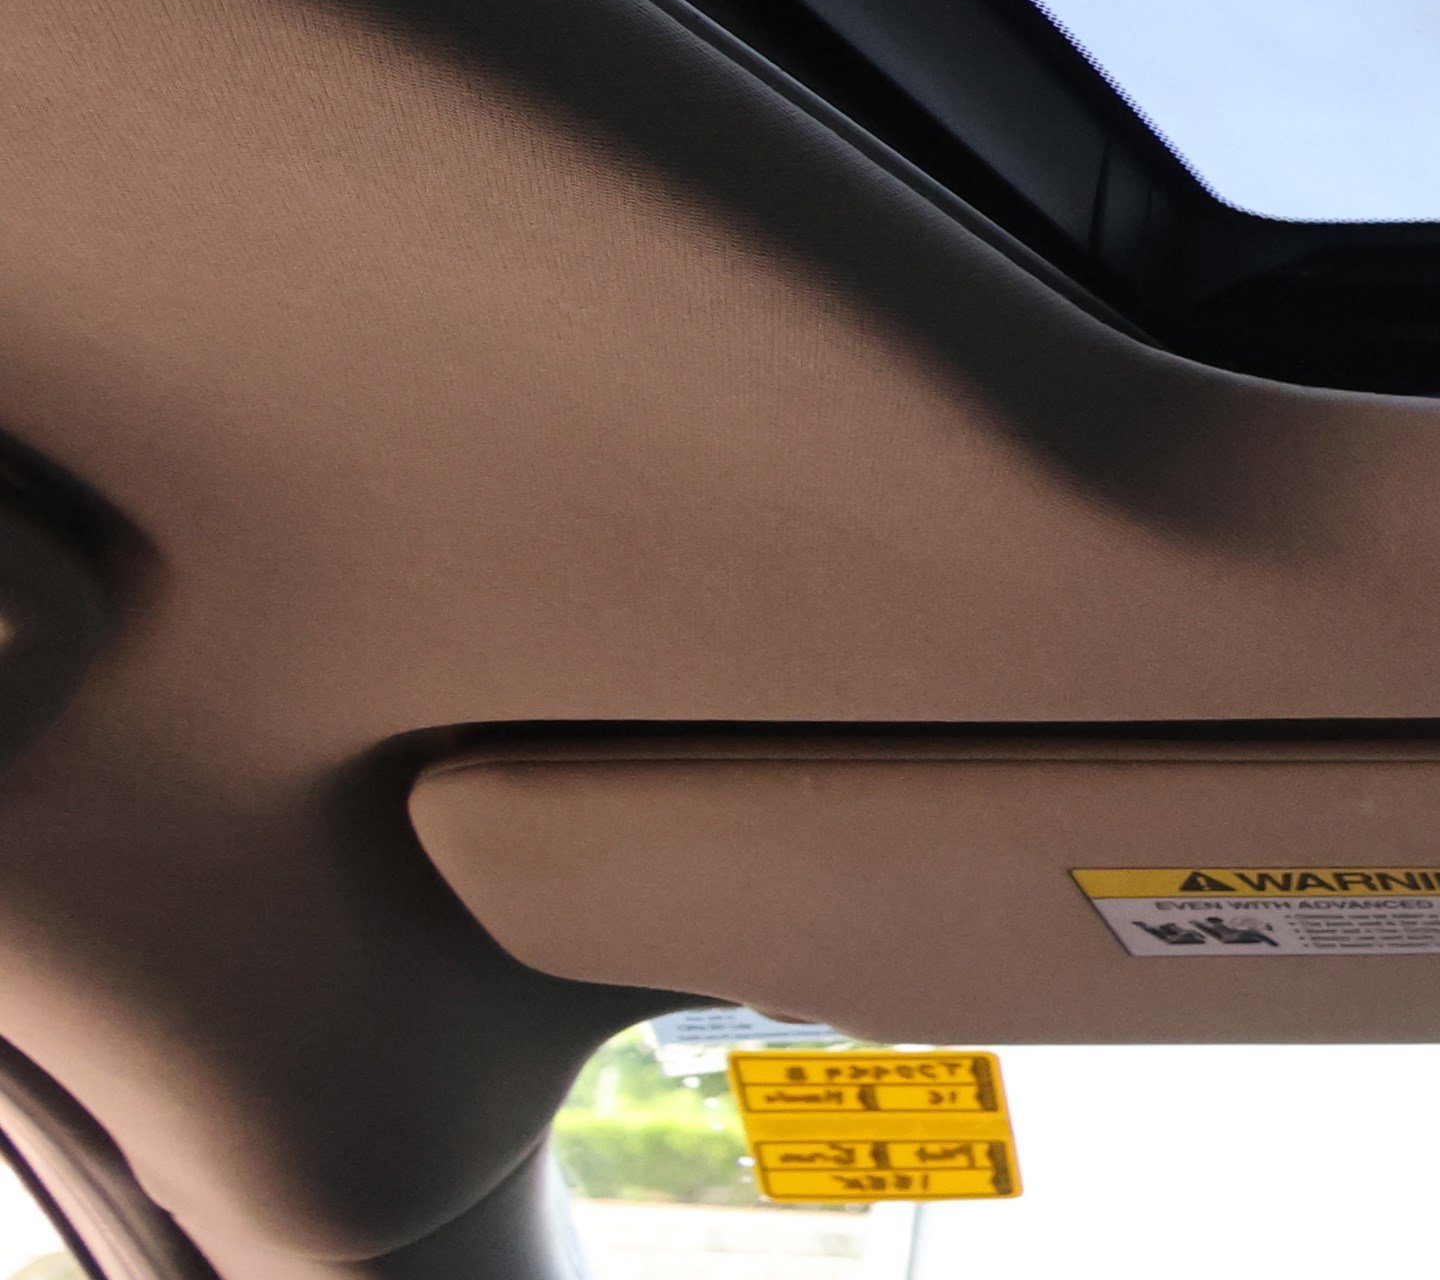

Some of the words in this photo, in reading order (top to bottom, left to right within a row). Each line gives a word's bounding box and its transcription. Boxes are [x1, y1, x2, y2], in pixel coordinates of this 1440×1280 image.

[1155, 901, 1221, 911] EVEN
[1228, 900, 1292, 911] WITH
[1298, 899, 1434, 910] ADVANCED
